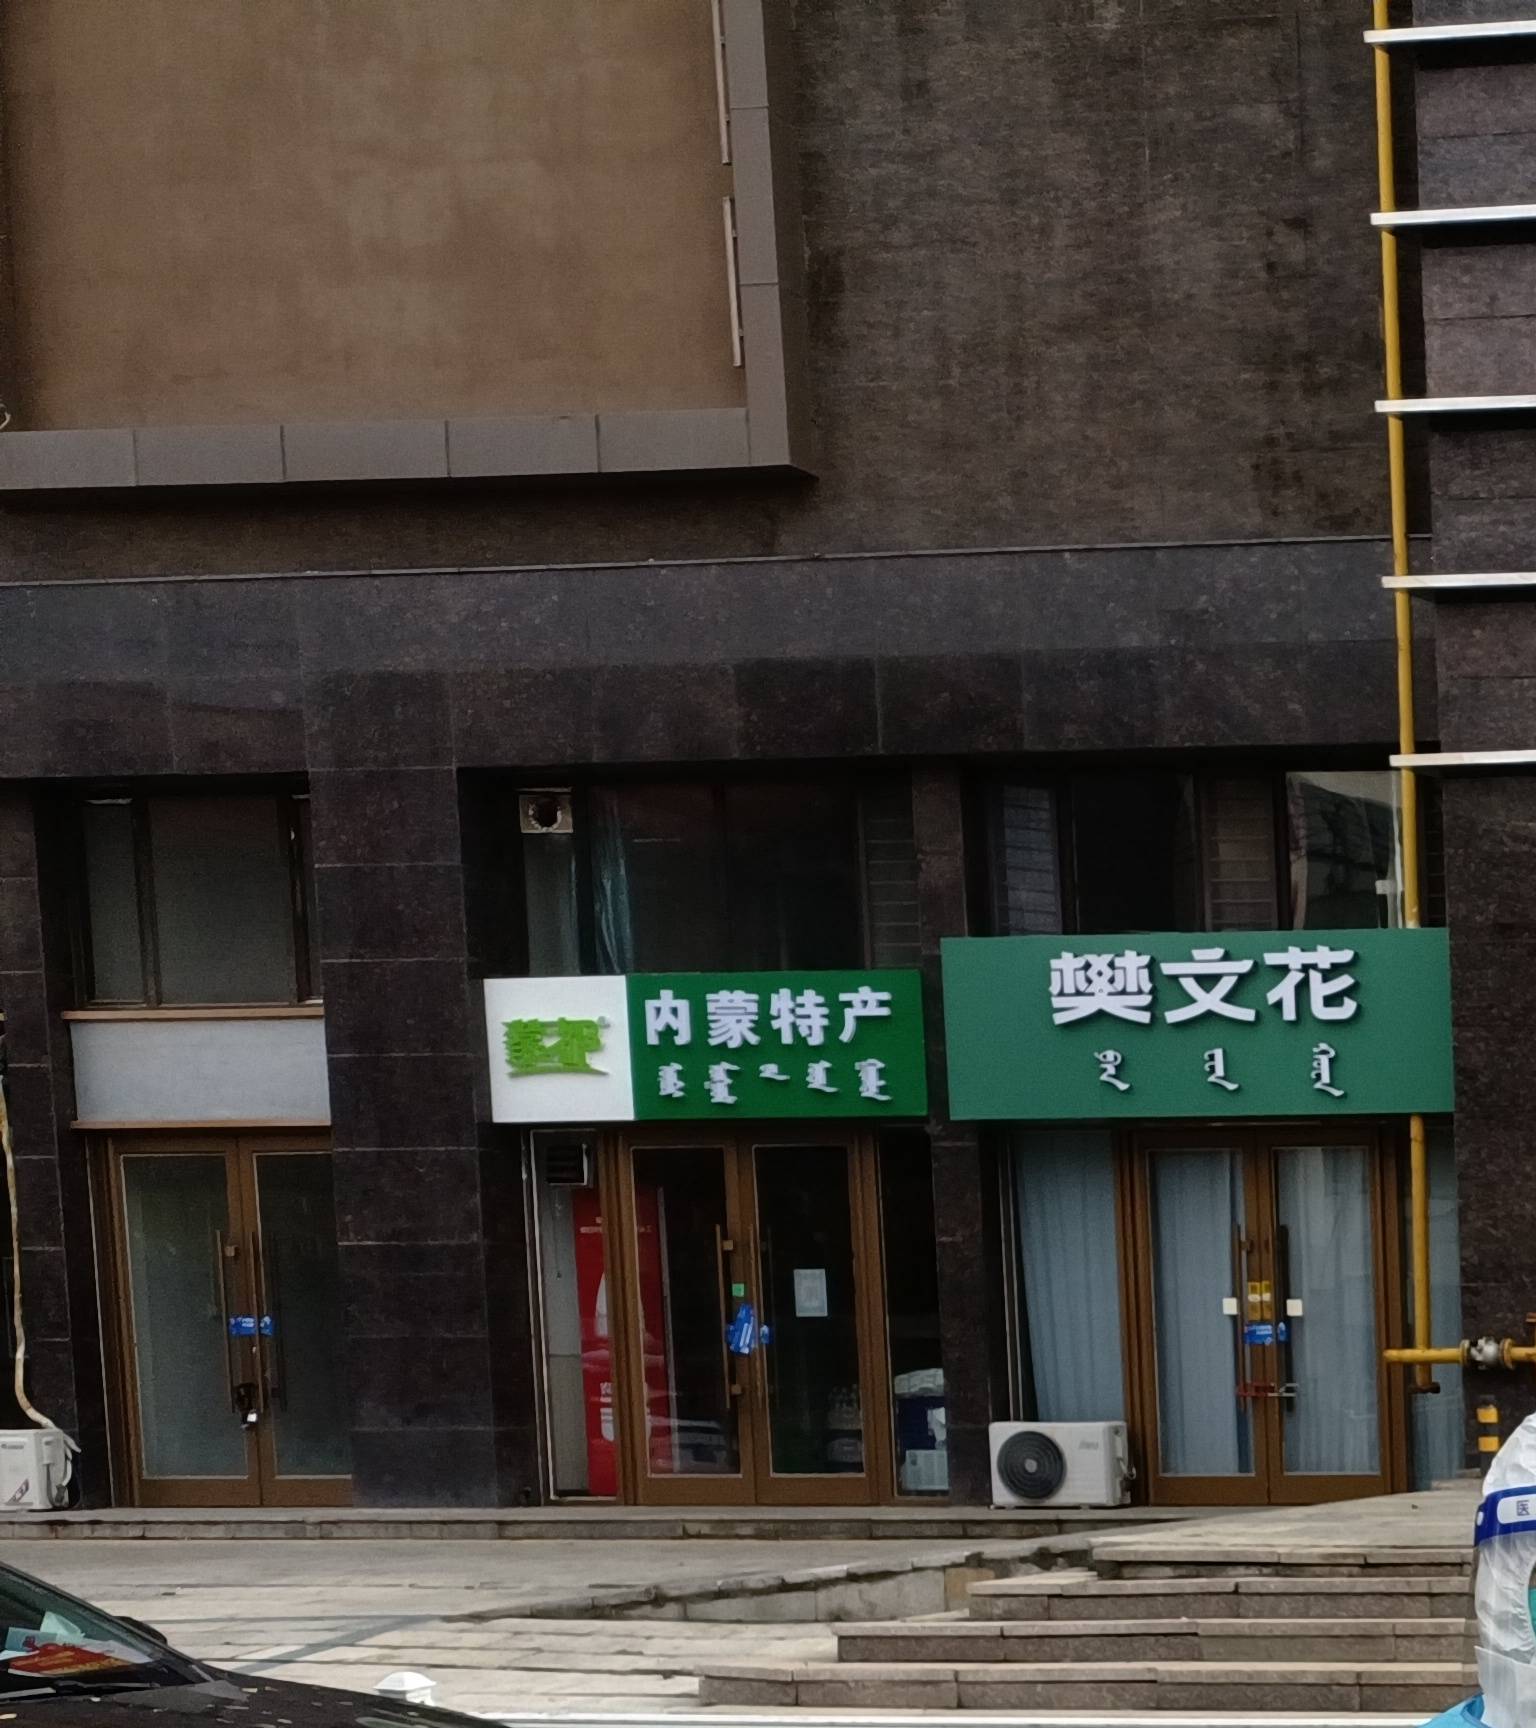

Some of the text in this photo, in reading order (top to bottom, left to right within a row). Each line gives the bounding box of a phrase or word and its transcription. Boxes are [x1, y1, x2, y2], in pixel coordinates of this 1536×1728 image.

[644, 985, 893, 1049] 内蒙特产
[1048, 944, 1358, 1027] 樊文花
